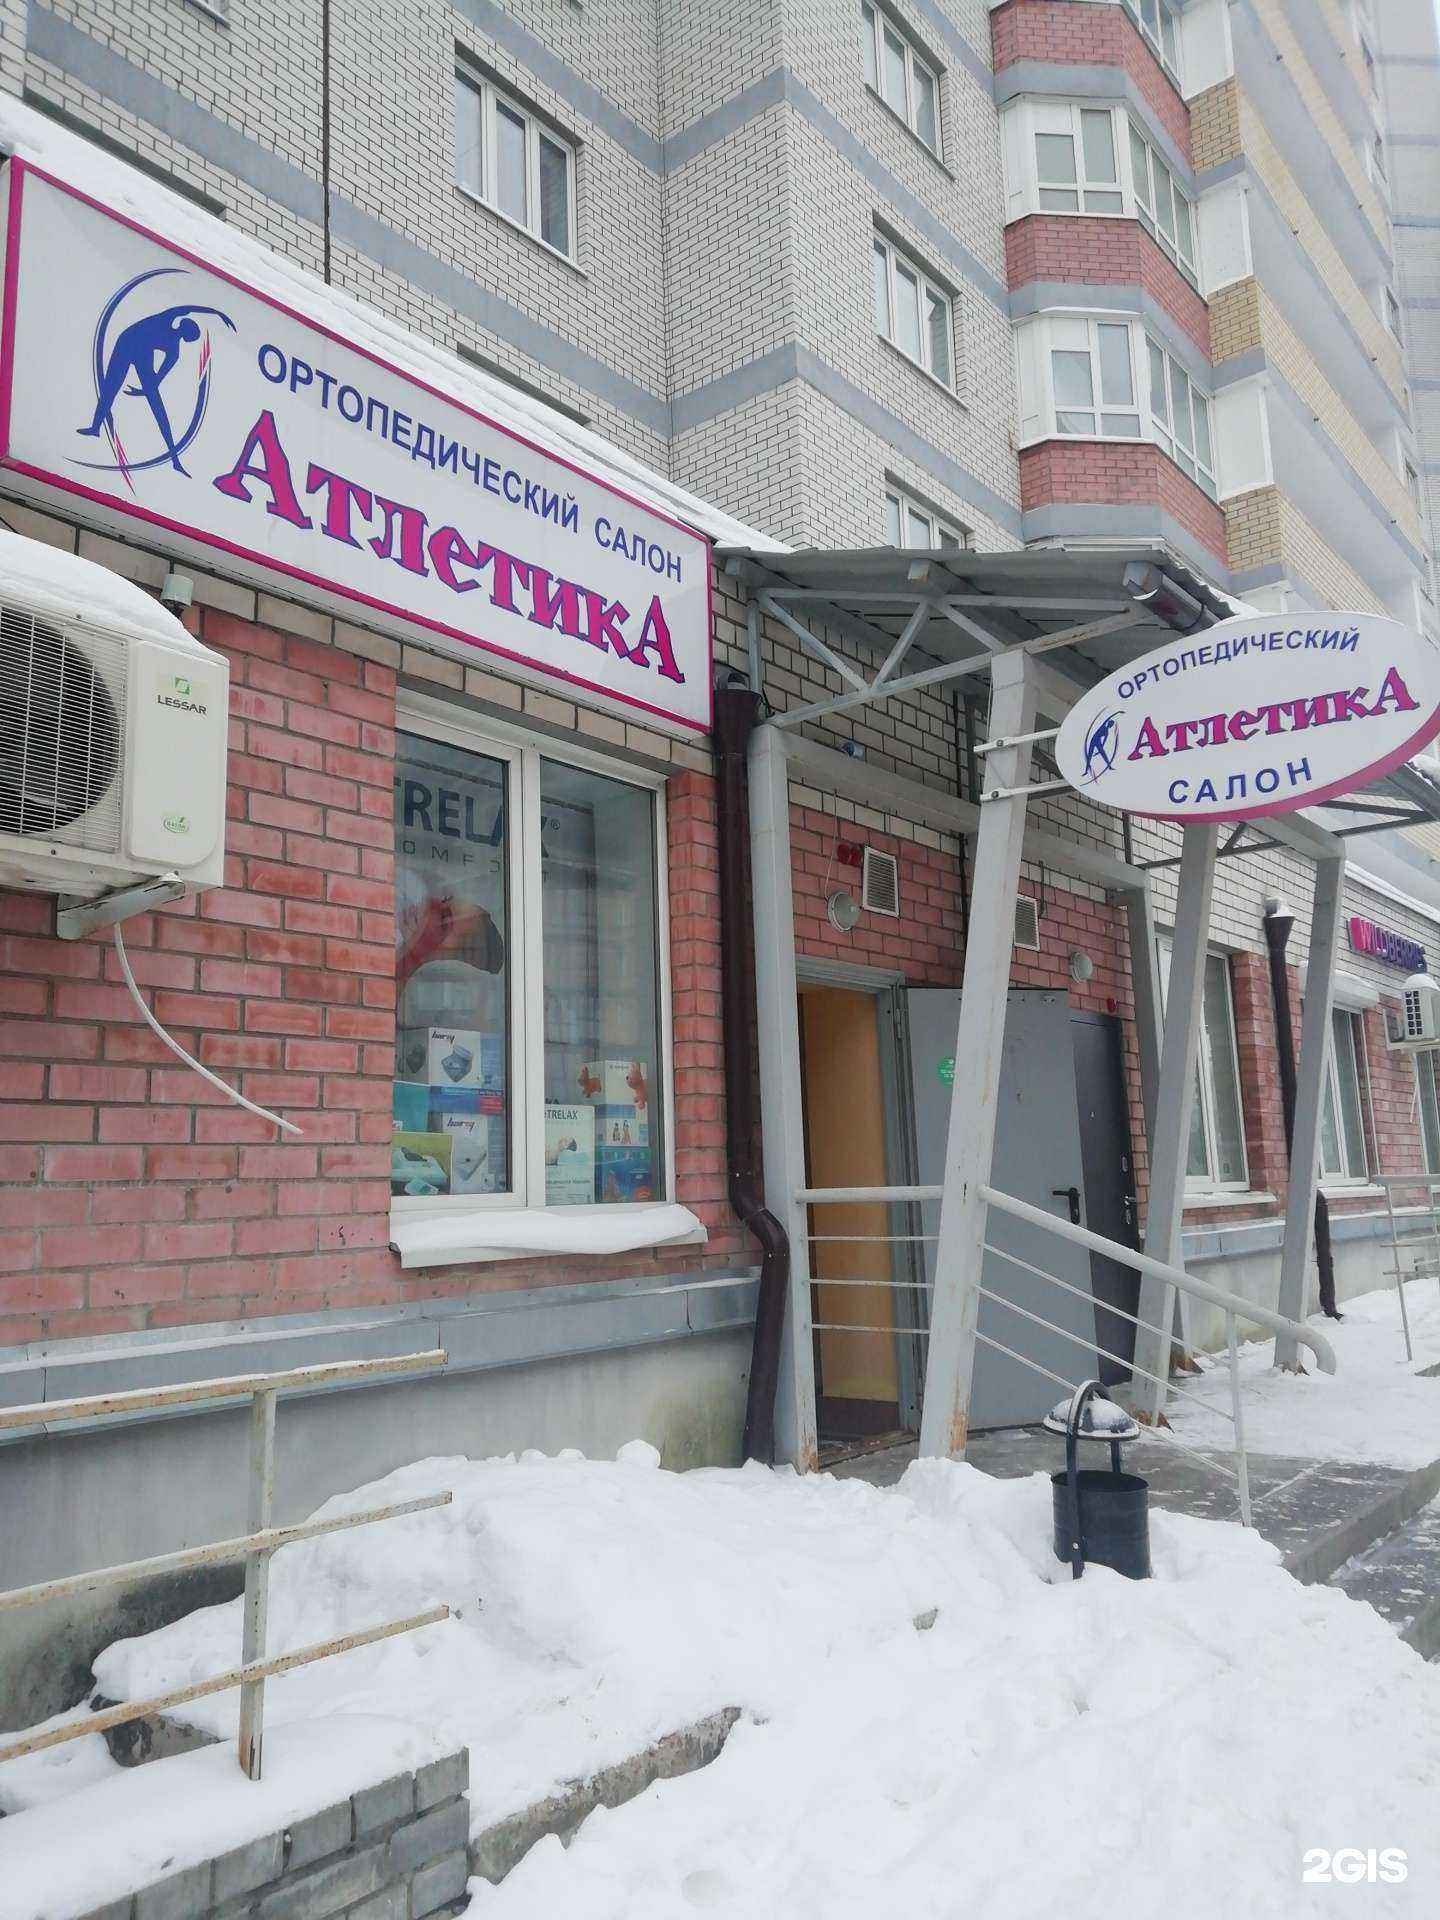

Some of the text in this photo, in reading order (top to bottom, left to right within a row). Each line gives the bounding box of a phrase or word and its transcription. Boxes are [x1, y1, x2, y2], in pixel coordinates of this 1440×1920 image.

[257, 343, 684, 583] ОРТОПЕДИЧЕСКИЙ САЛОН
[1117, 627, 1361, 700] ОРТОПЕДИЧЕСКИЙ
[157, 694, 208, 716] LESSAR
[1168, 756, 1313, 804] САЛОН
